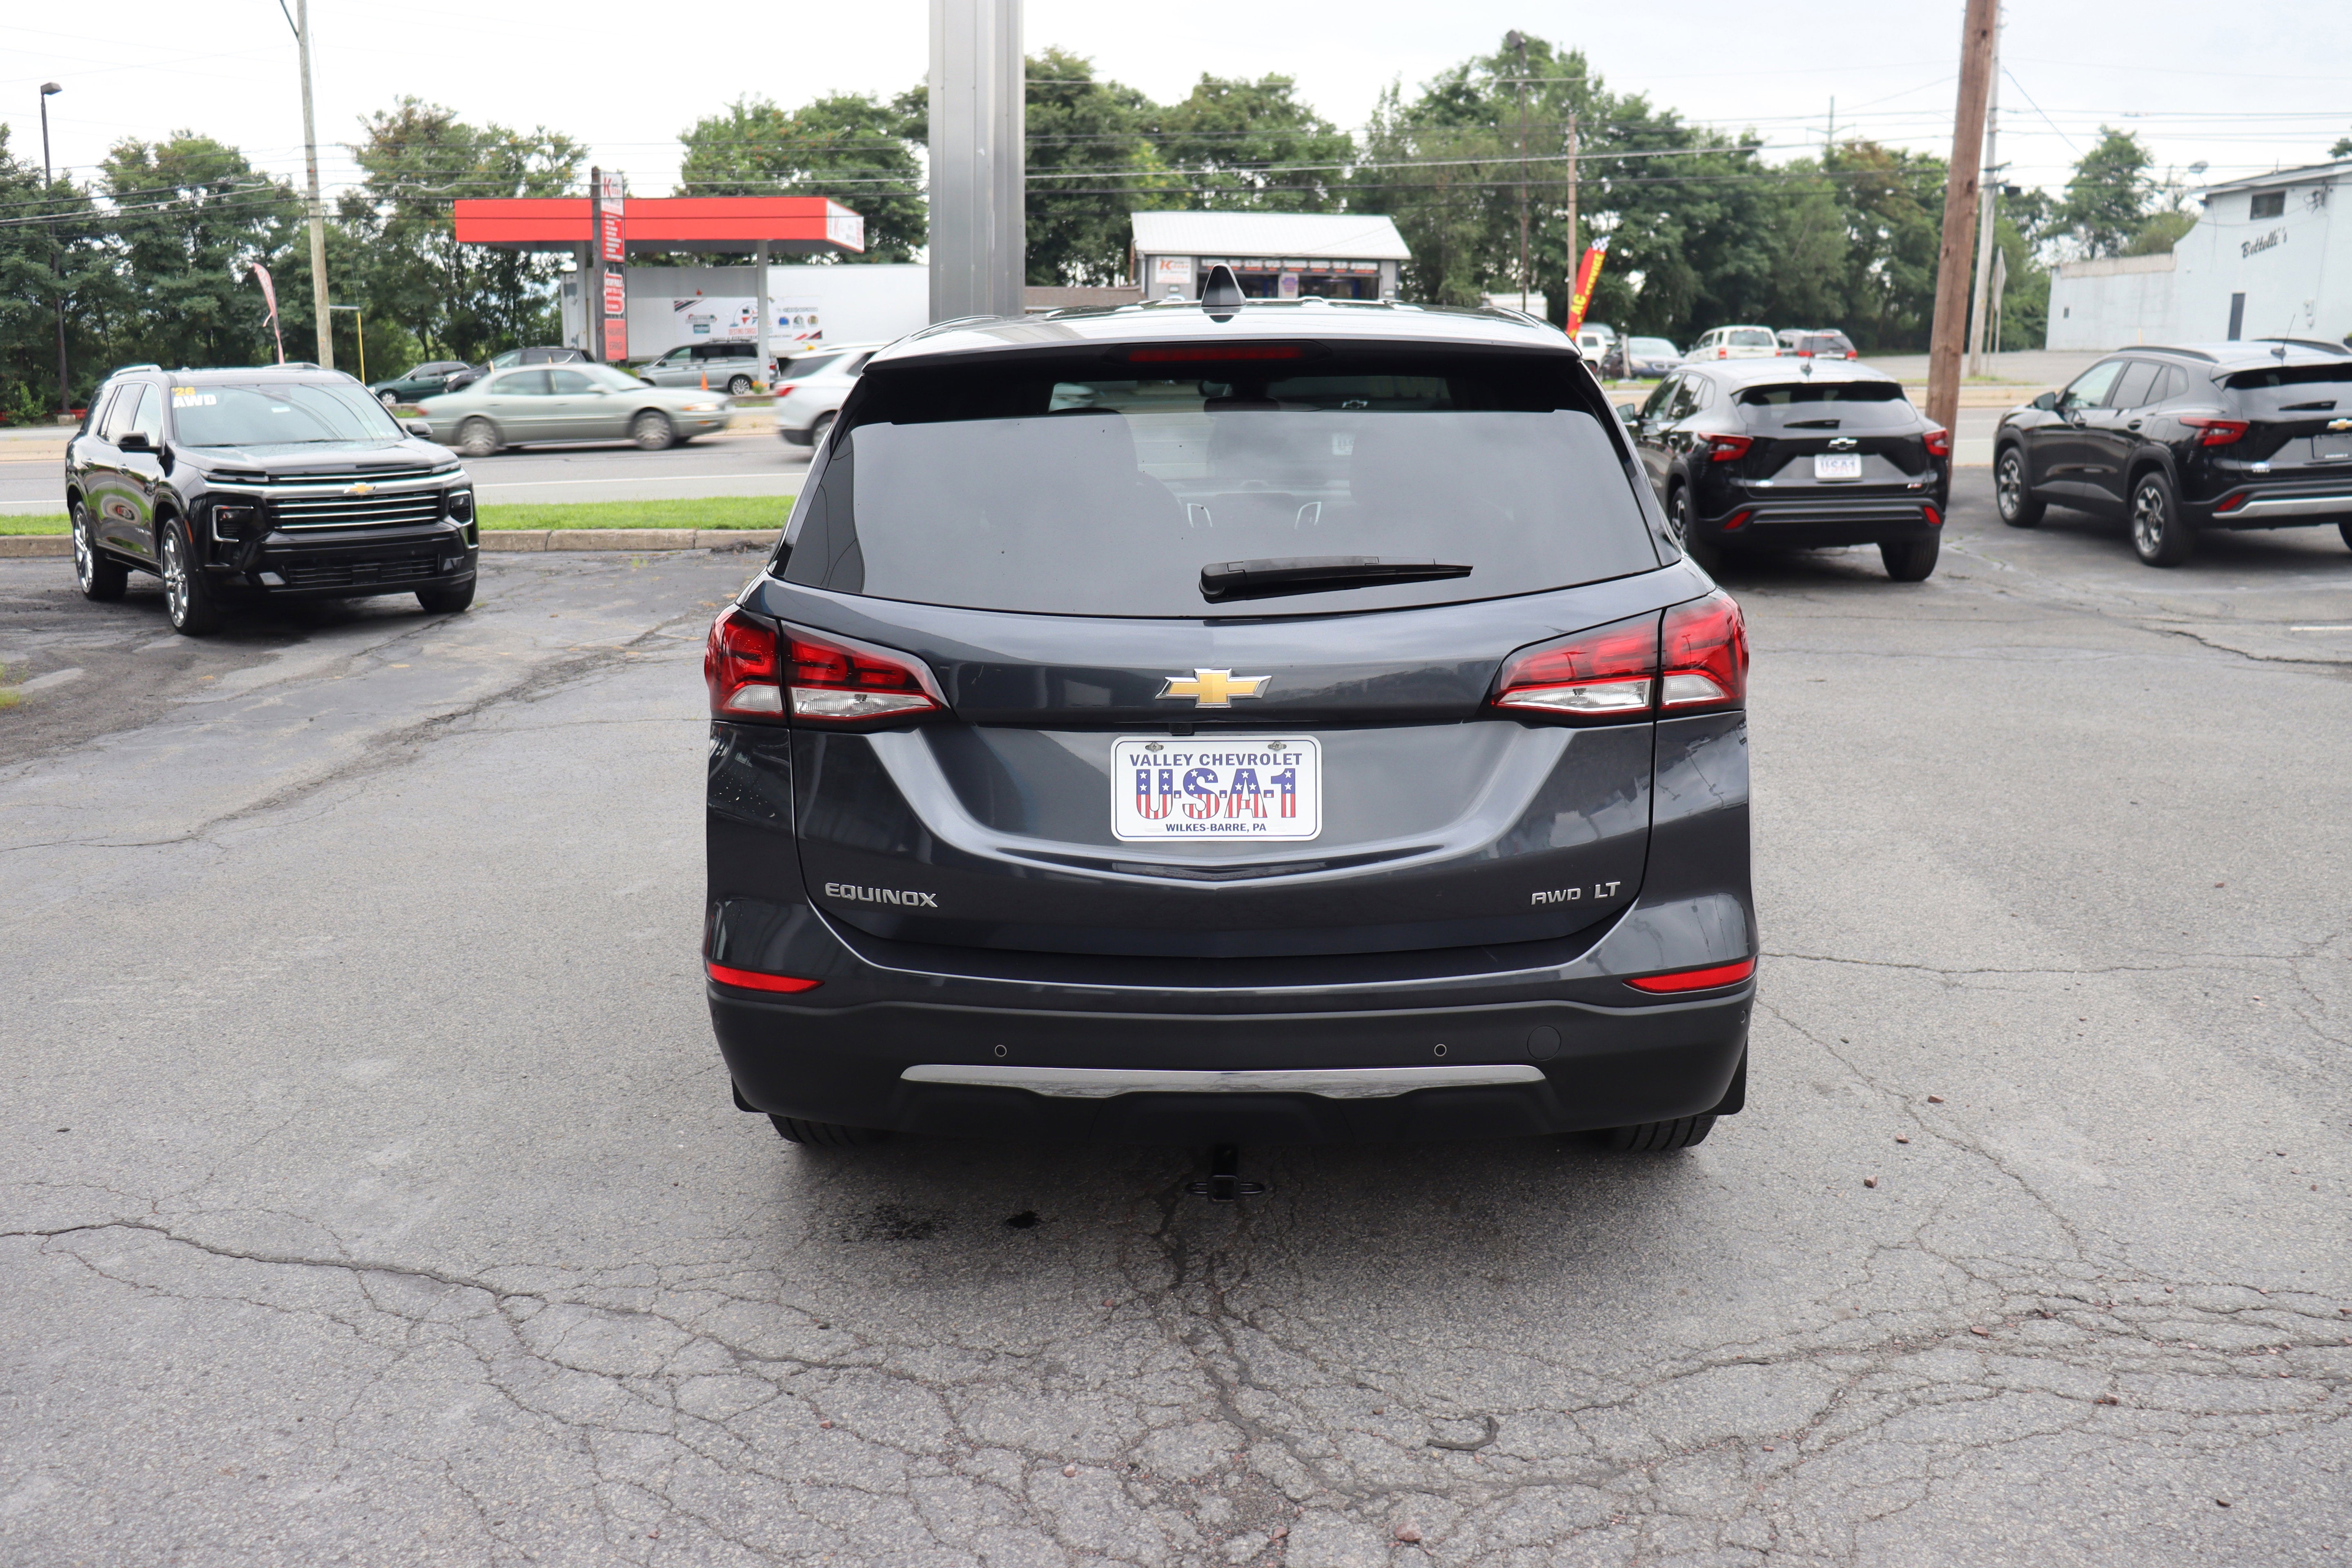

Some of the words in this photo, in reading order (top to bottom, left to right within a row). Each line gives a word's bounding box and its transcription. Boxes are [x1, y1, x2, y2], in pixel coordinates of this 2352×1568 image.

[173, 394, 217, 408] AWD
[1129, 754, 1194, 766] VALLEY
[1199, 753, 1302, 766] CHEVROLET
[1166, 824, 1250, 833] WILKES-BARRE,
[825, 882, 938, 908] EQUINOX
[1531, 888, 1581, 905] AWD
[1594, 881, 1621, 898] LT
